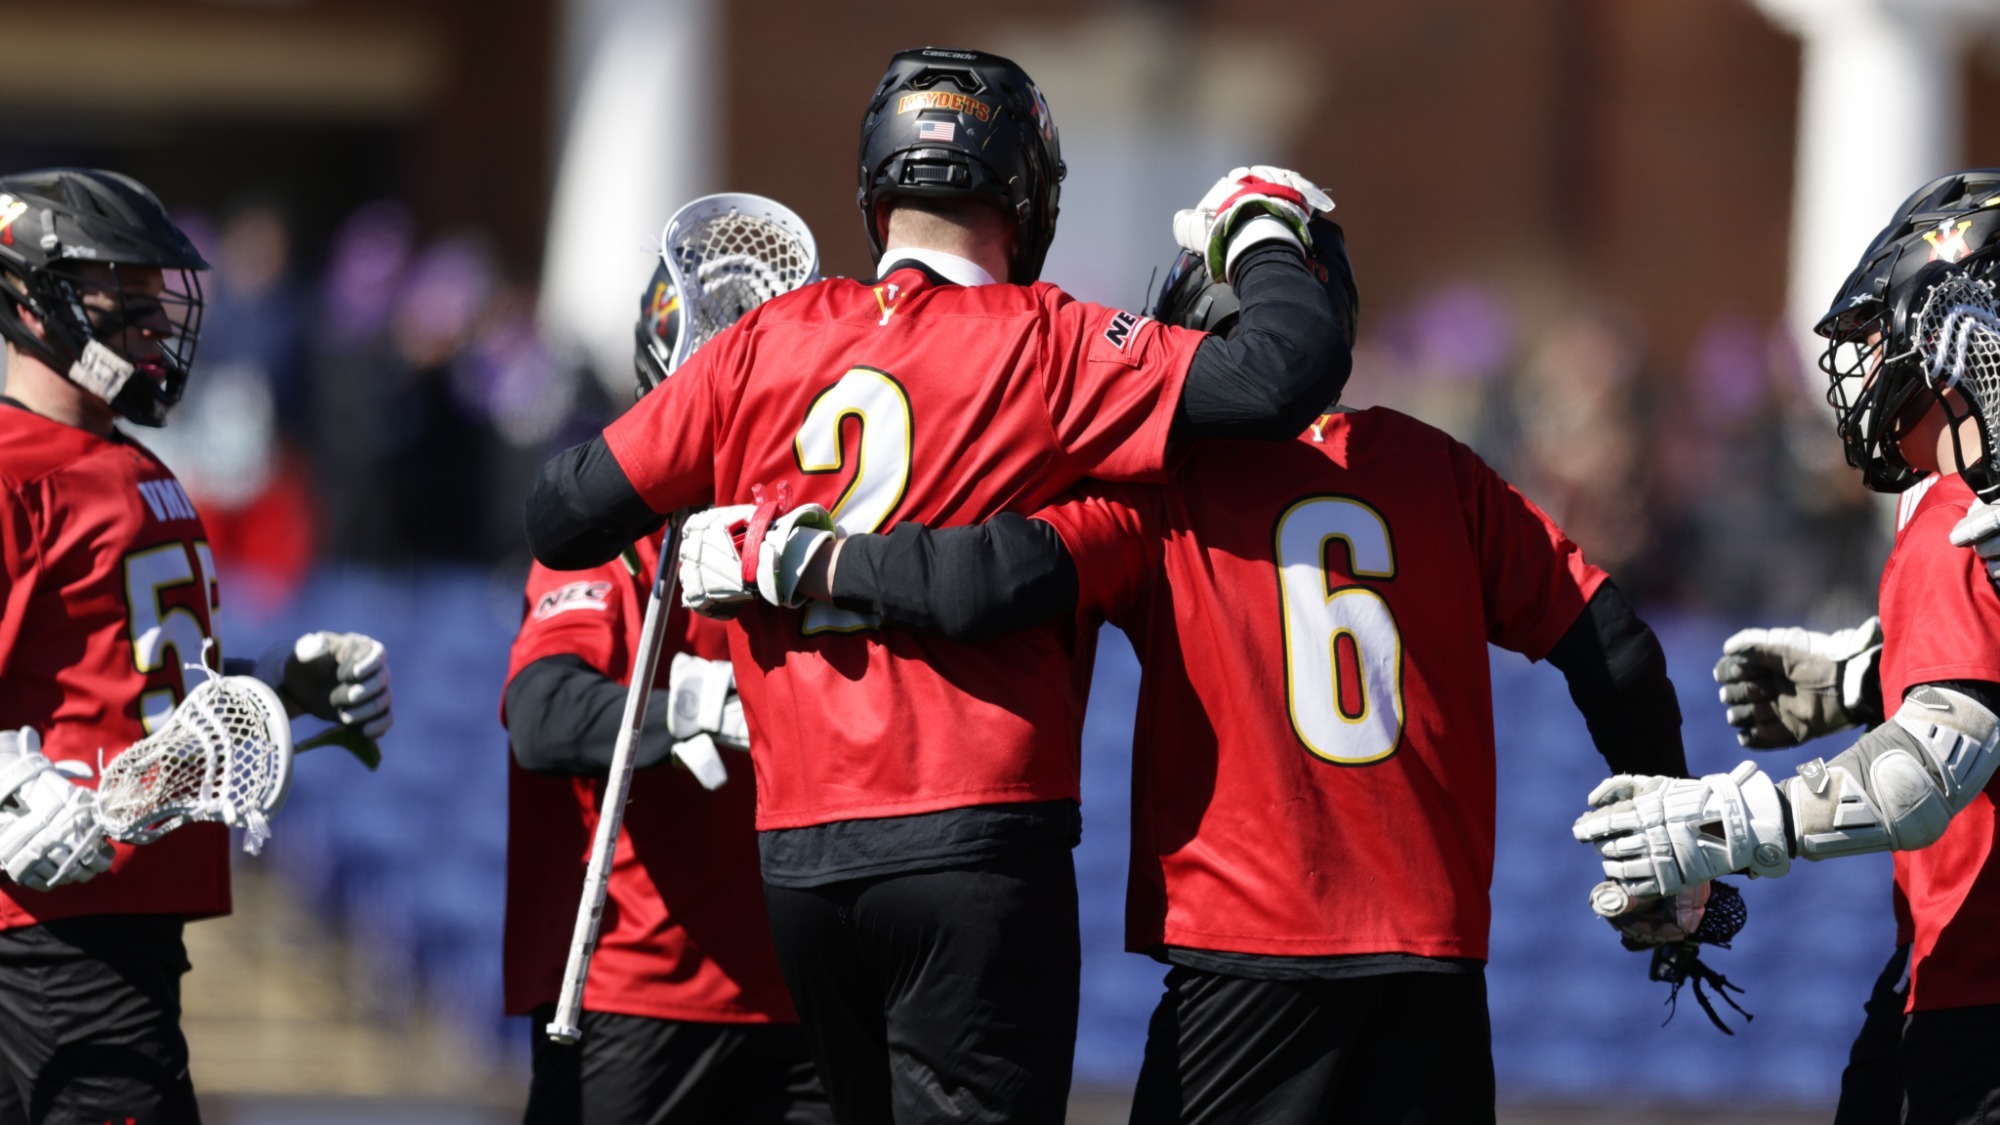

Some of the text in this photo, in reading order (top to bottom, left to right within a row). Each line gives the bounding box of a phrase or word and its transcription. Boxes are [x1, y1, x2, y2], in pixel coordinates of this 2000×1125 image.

[921, 50, 978, 60] cascade
[897, 91, 990, 122] KEYDETS
[1104, 309, 1139, 350] NE
[795, 366, 914, 636] 2
[1276, 493, 1404, 767] 6
